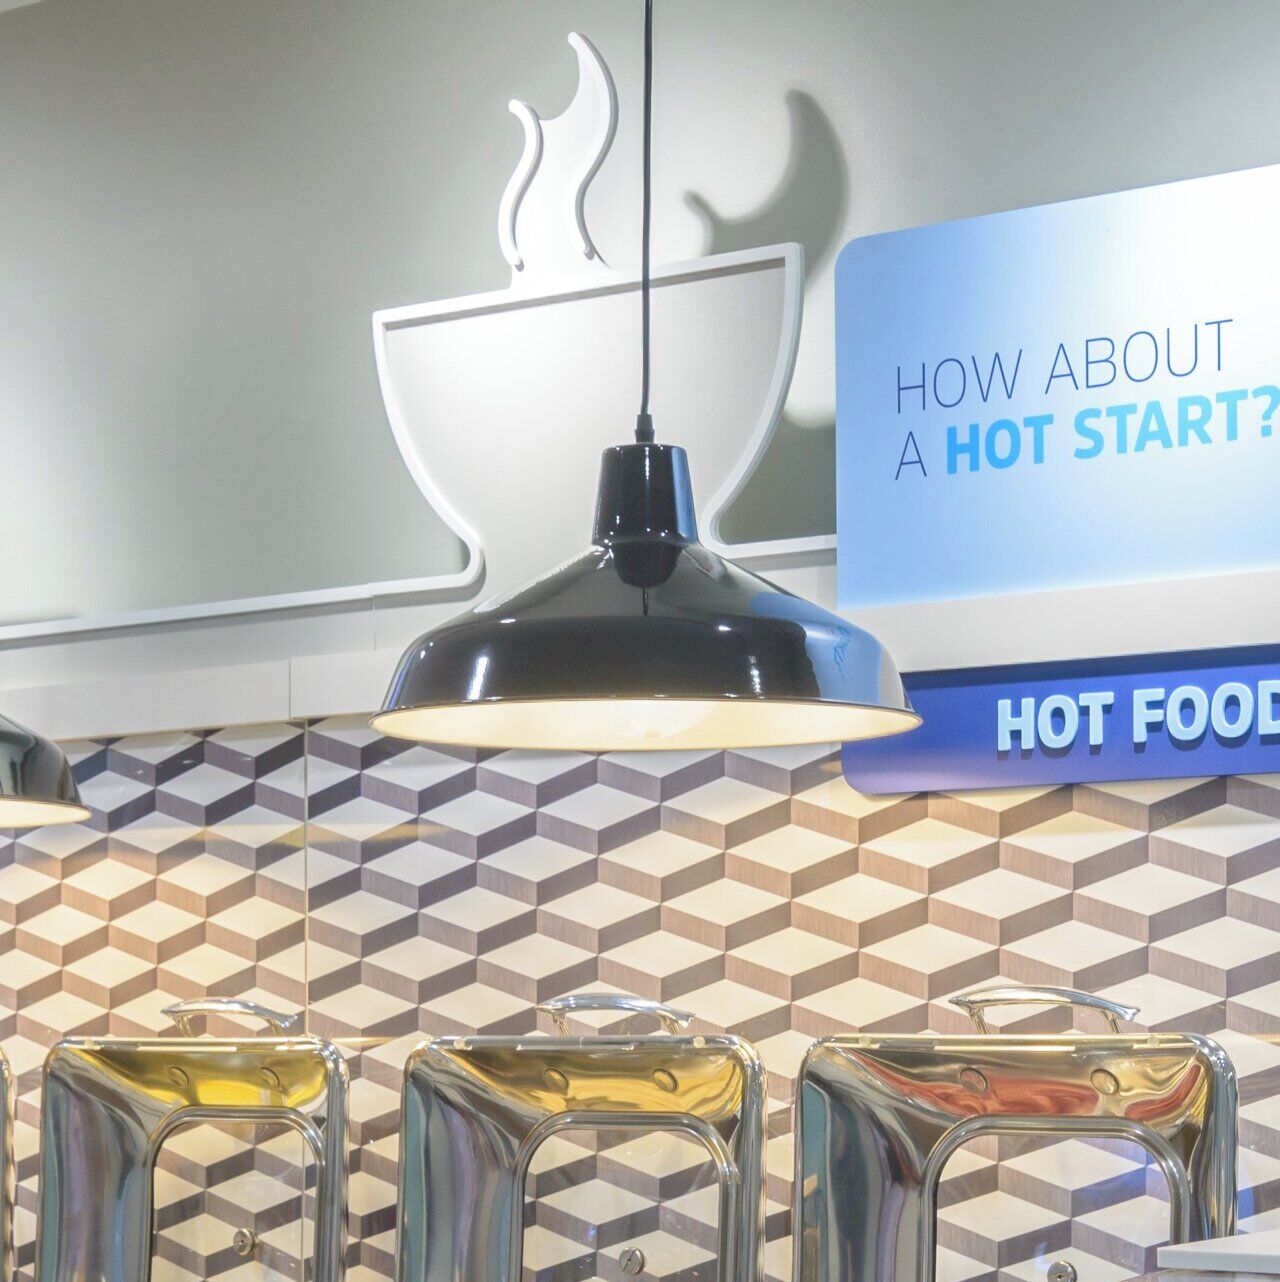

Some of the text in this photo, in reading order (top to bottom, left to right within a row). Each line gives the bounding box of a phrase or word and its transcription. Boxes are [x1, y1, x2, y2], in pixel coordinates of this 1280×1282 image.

[898, 319, 1234, 414] HOW ABOUT
[895, 431, 927, 480] A
[946, 413, 1054, 475] HOT
[998, 690, 1115, 752] HOT
